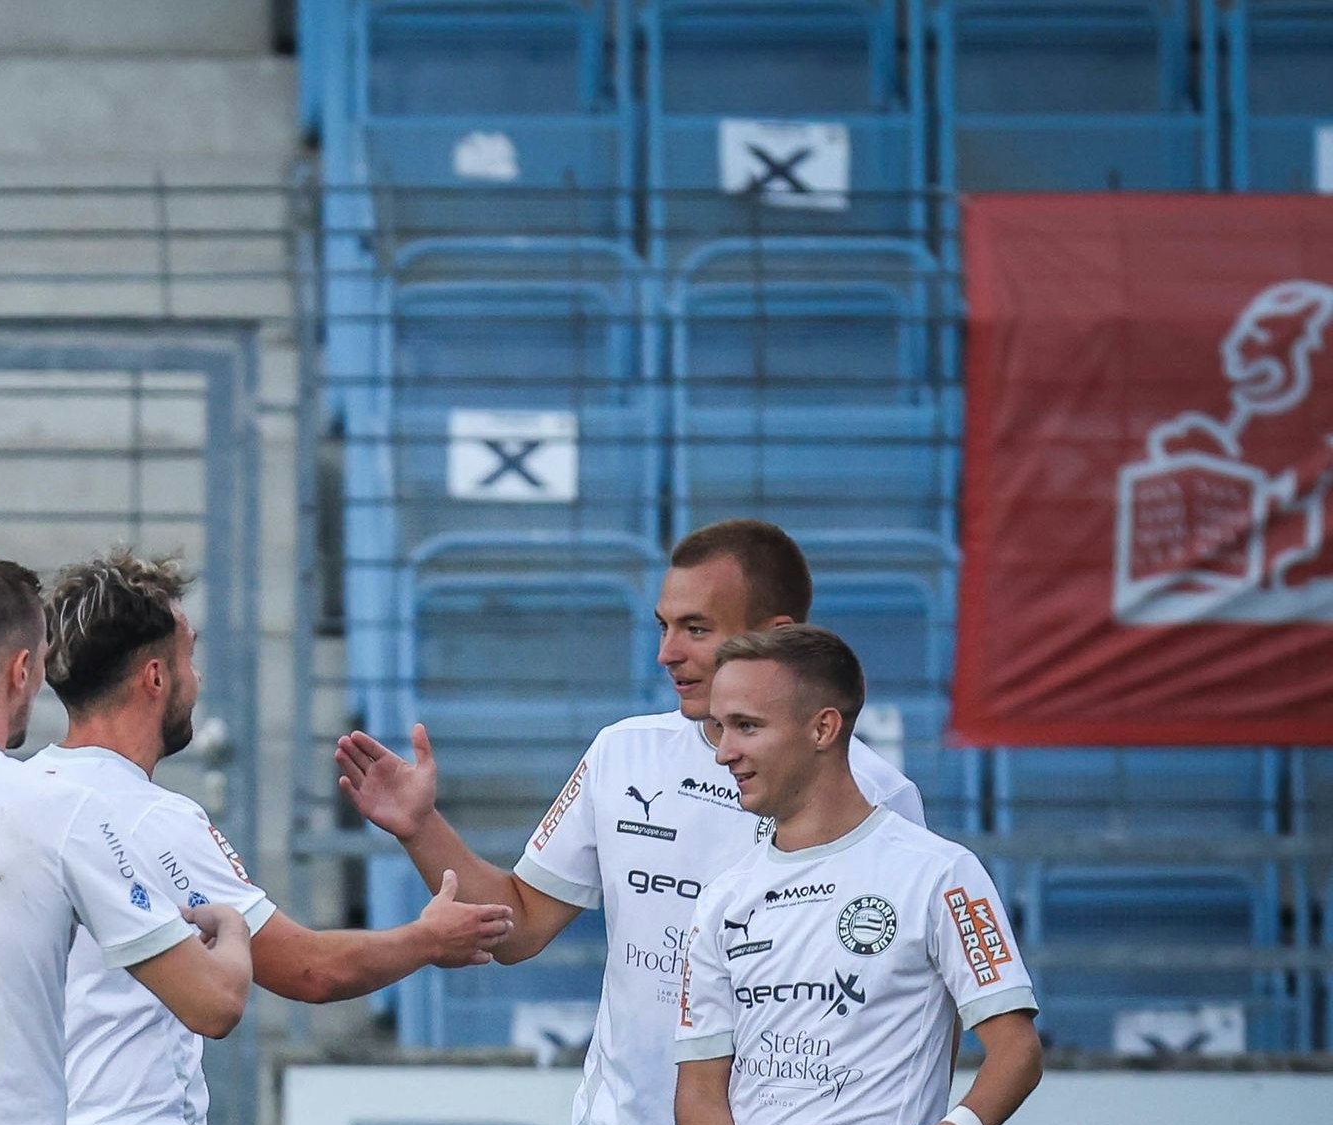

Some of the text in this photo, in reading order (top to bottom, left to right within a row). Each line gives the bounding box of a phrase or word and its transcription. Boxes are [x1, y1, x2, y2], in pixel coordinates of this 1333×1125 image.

[699, 782, 740, 803] MOM
[100, 822, 135, 879] MIIND
[628, 870, 702, 900] geo
[784, 883, 836, 900] MOMO
[948, 892, 995, 983] ENERGIE
[973, 904, 1007, 961] WIEN
[626, 943, 685, 976] Proch
[760, 1030, 831, 1056] Stefan
